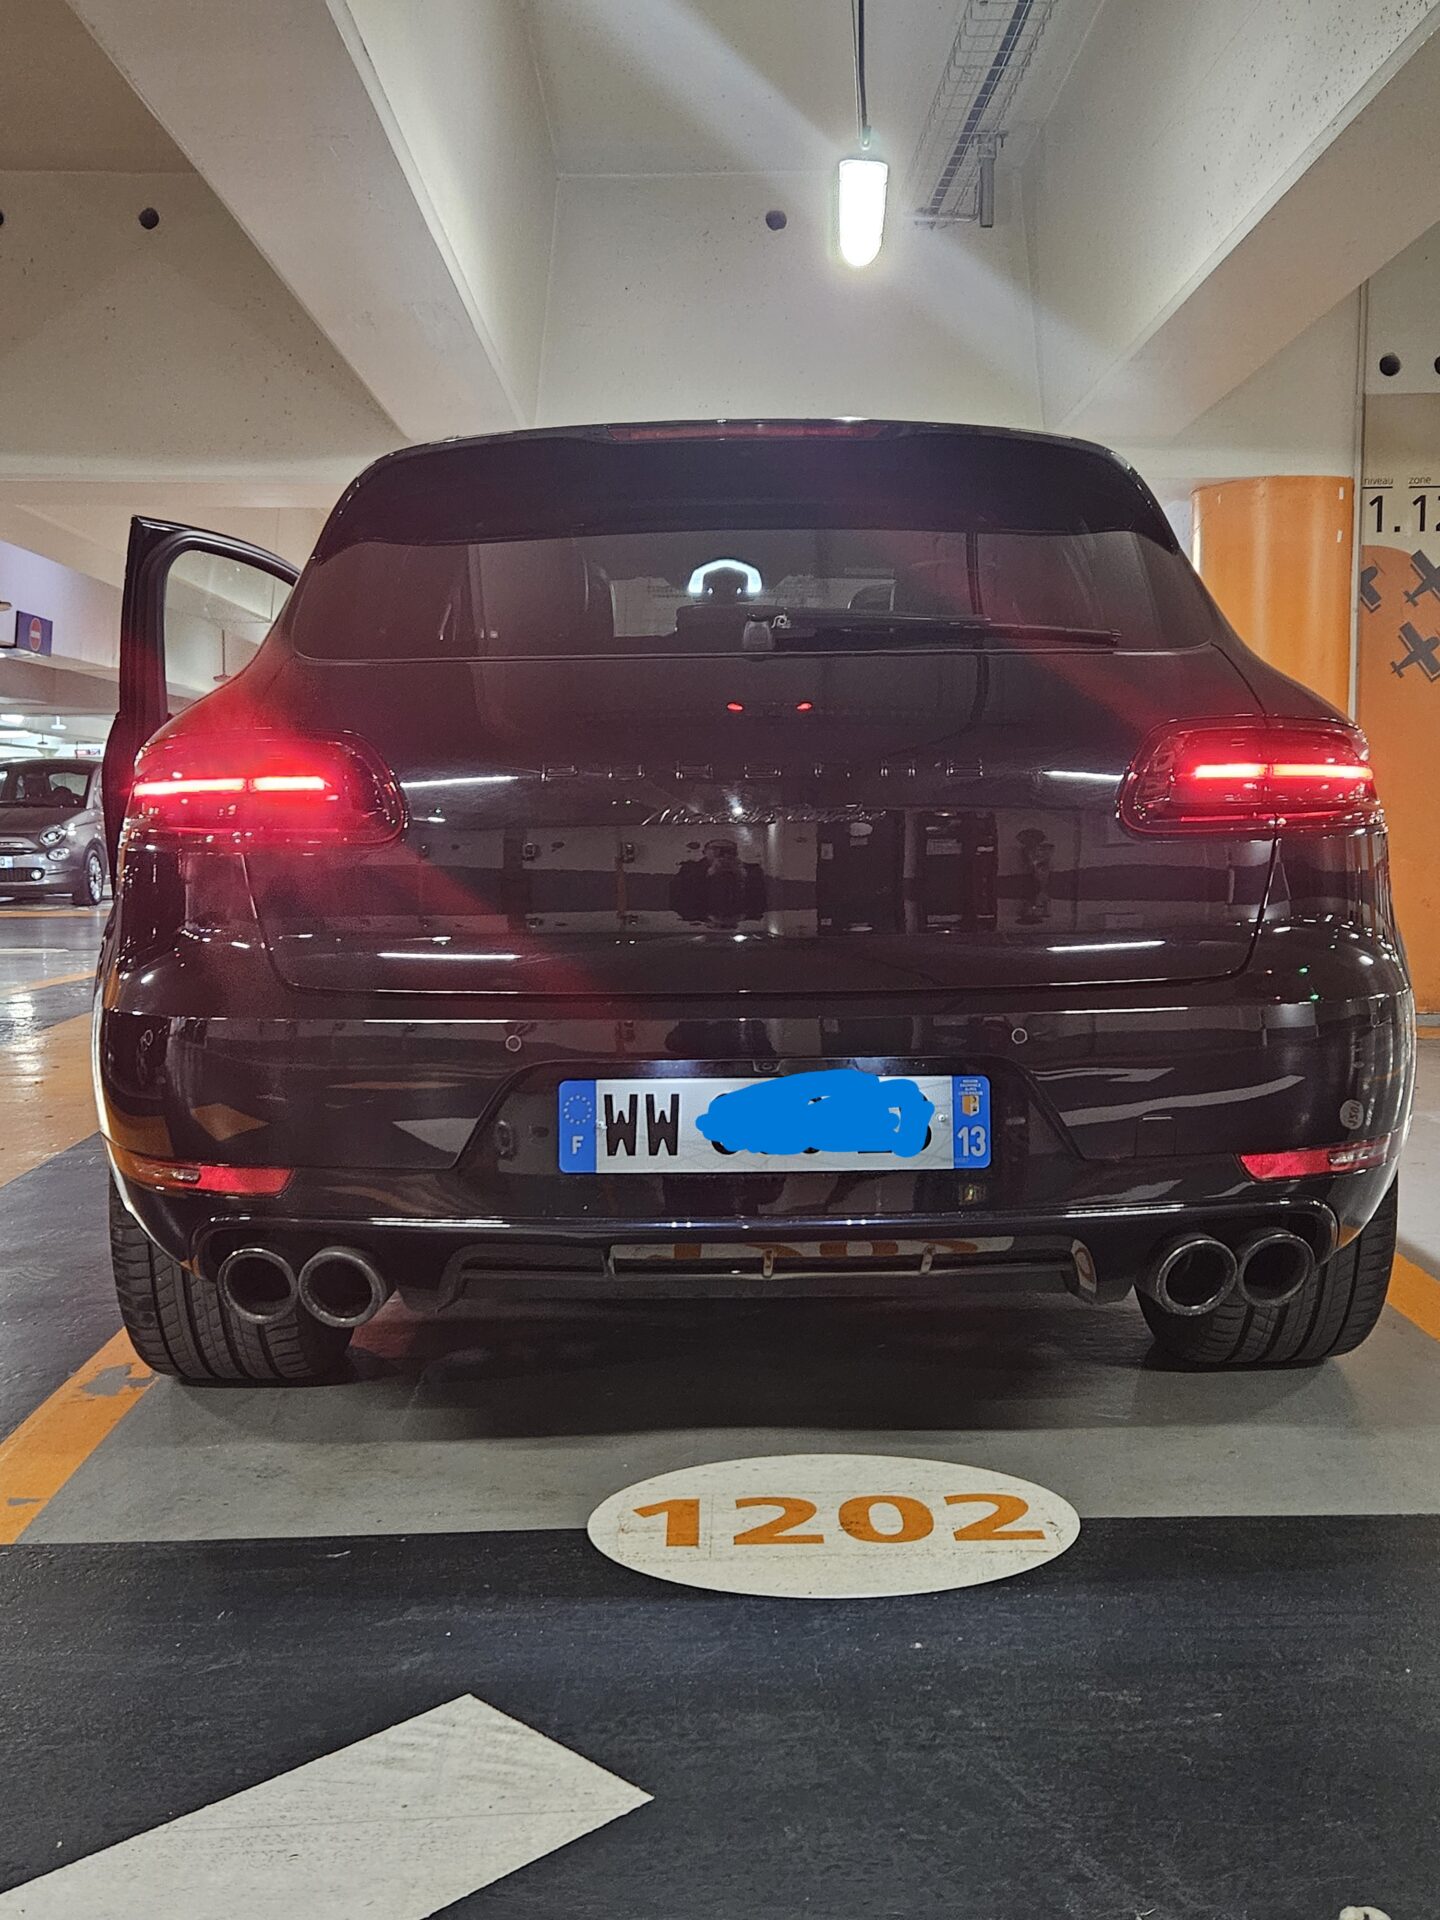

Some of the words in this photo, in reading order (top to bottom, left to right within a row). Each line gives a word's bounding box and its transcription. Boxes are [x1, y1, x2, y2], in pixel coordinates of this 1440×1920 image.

[1408, 477, 1432, 485] zone
[604, 1094, 680, 1156] WW
[957, 1125, 987, 1157] 13
[571, 1135, 585, 1155] F
[633, 1493, 1046, 1548] 1202
